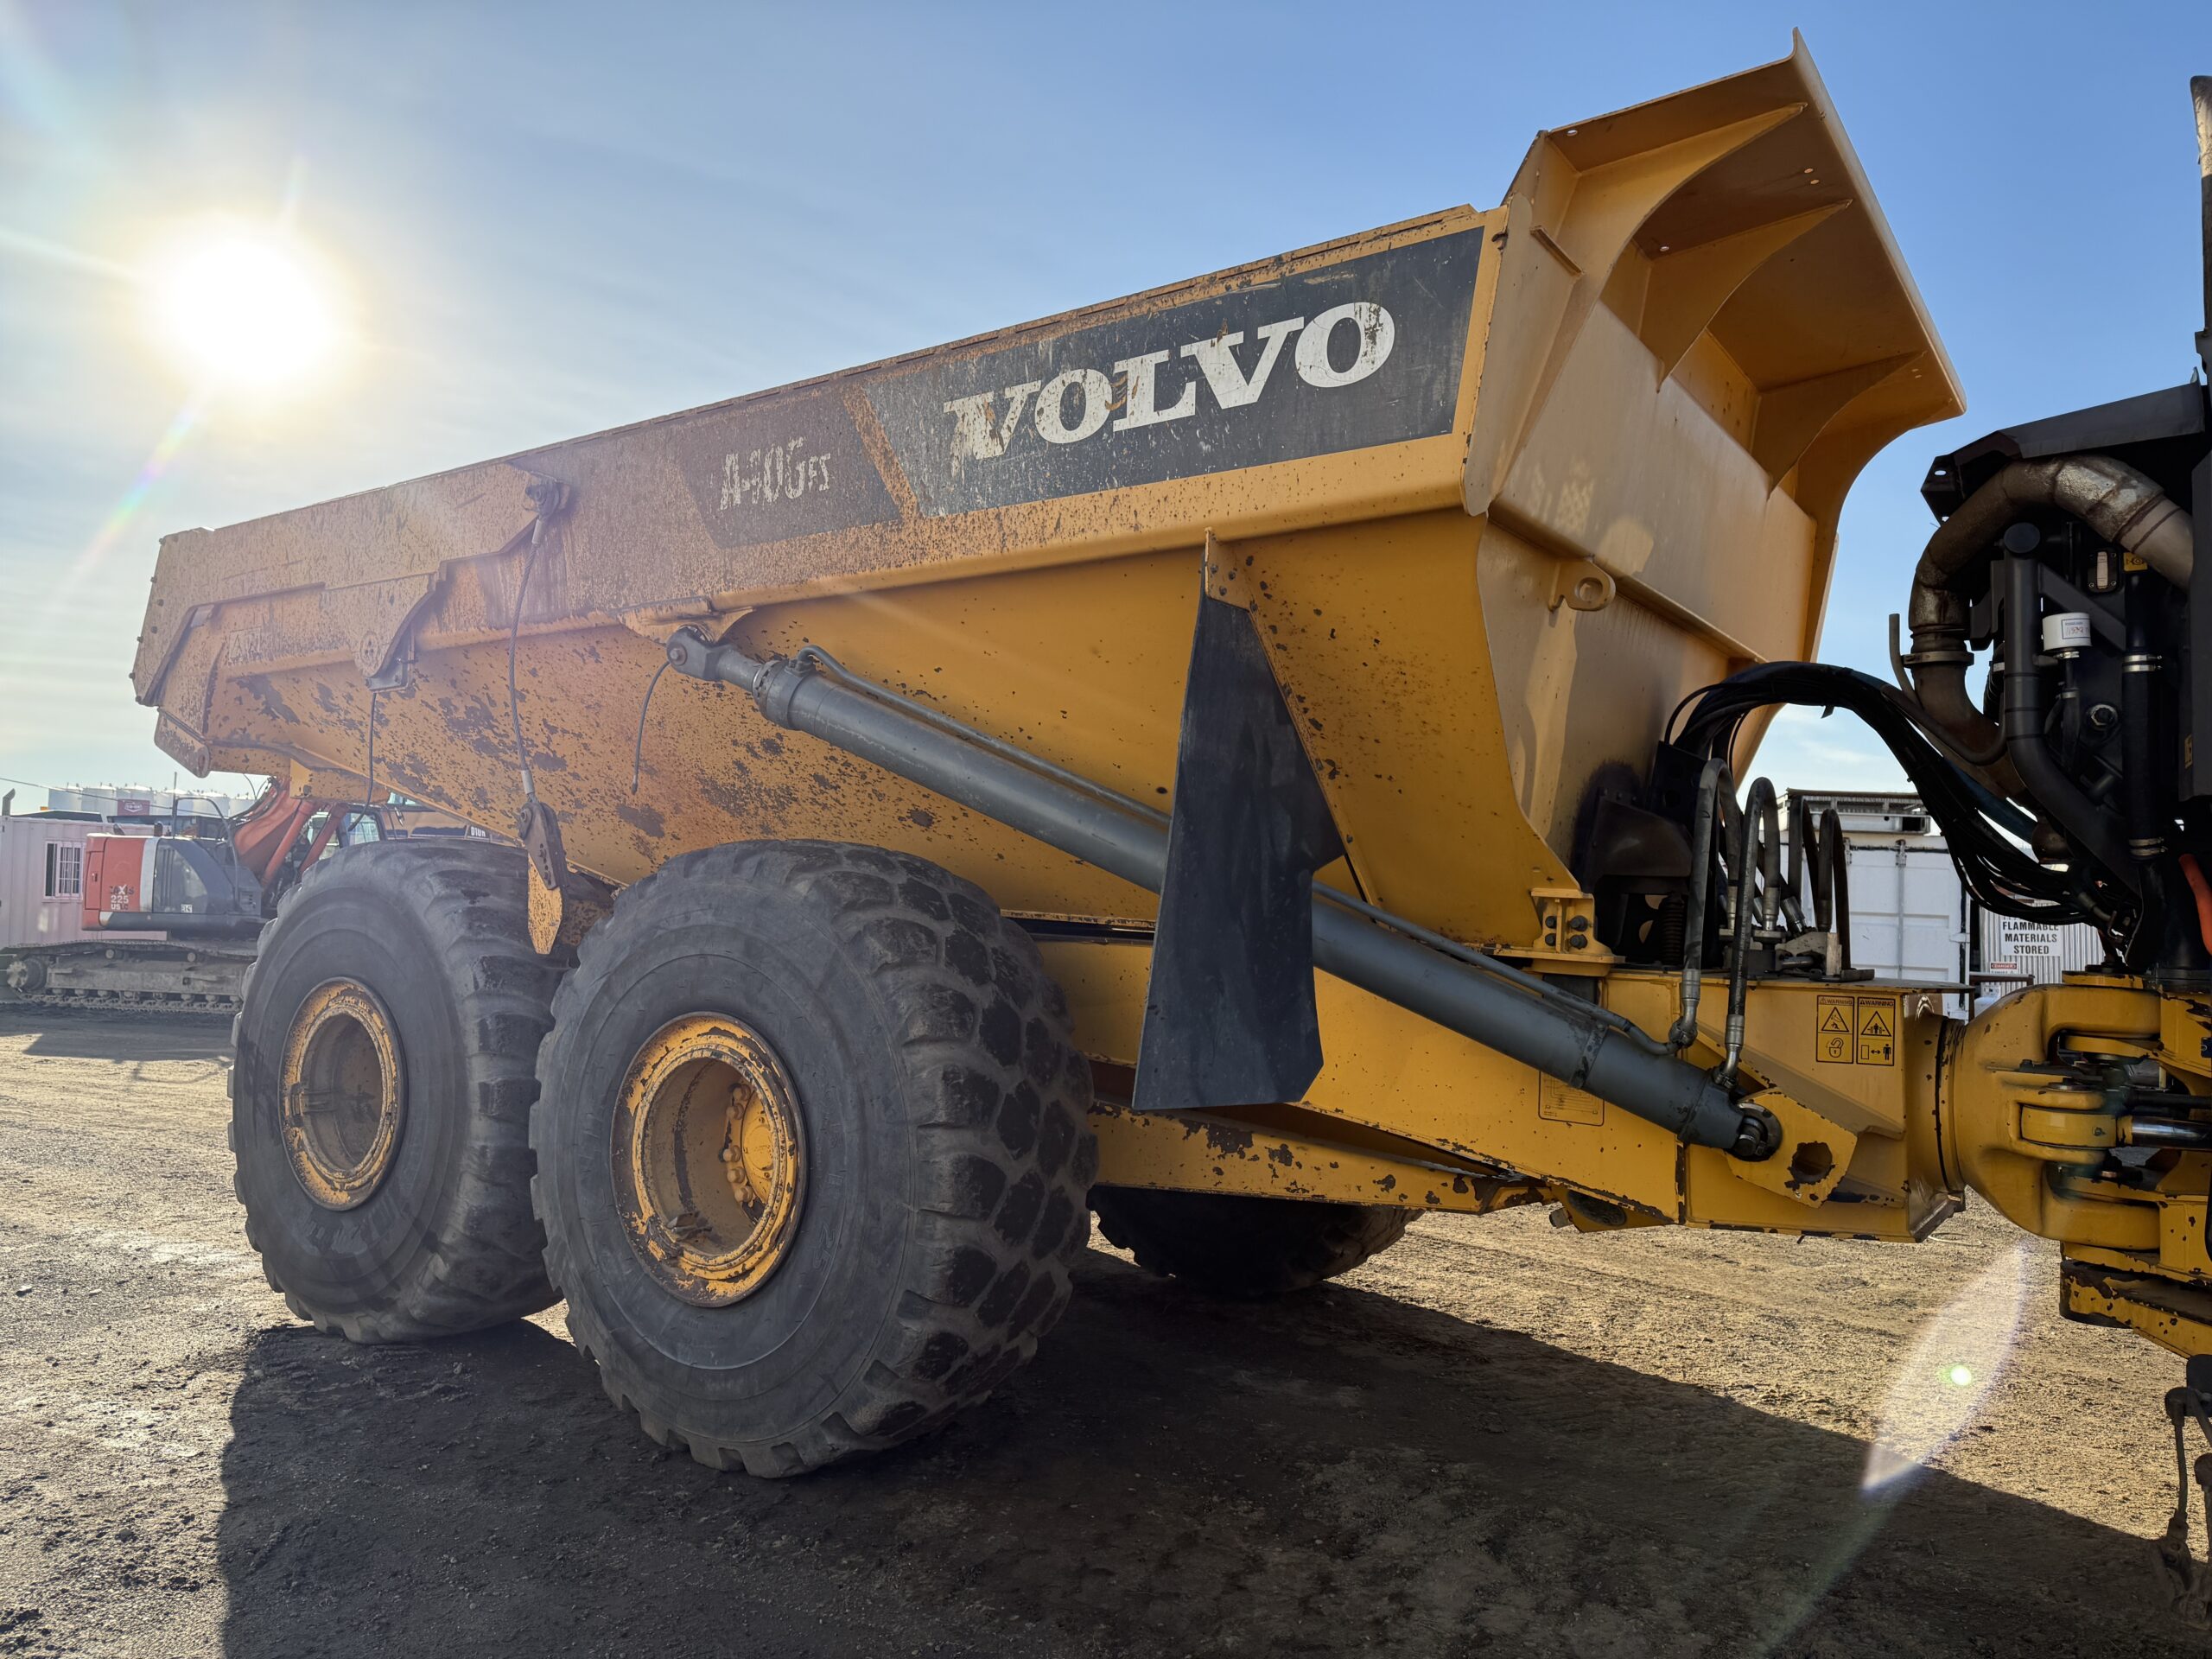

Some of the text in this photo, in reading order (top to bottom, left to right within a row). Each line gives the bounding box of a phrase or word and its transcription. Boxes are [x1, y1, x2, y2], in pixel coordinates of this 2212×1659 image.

[944, 302, 1395, 460] VOLVO
[111, 894, 130, 904] 225
[2003, 921, 2059, 931] FLAMMABLE
[2005, 933, 2057, 943] MATERIALS
[2013, 945, 2050, 954] STORED
